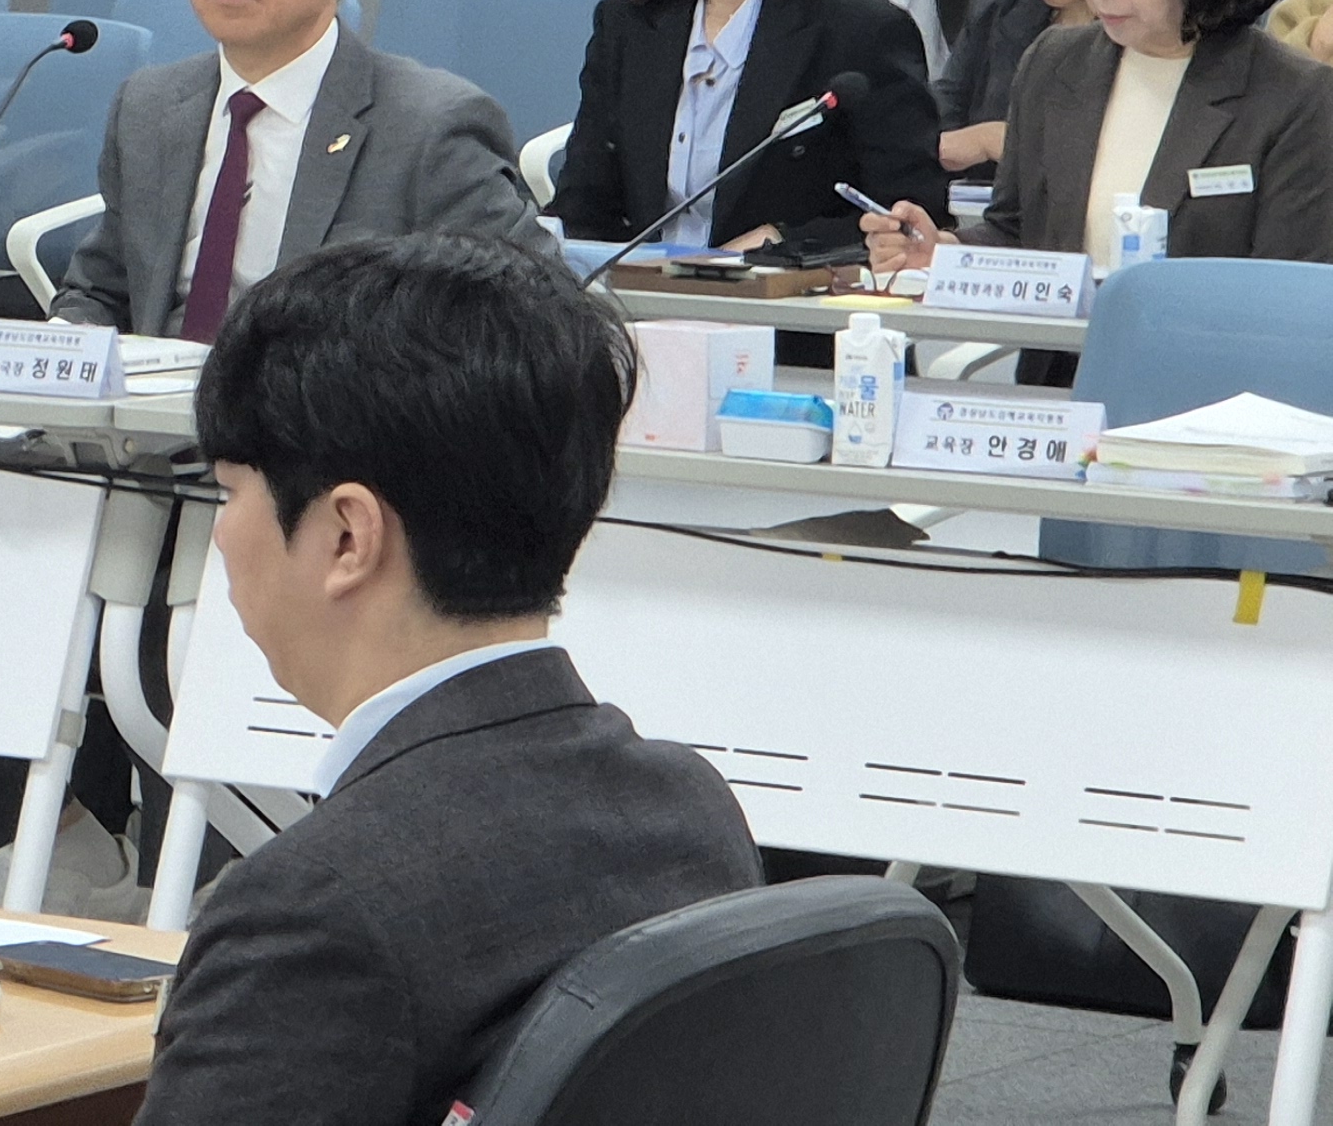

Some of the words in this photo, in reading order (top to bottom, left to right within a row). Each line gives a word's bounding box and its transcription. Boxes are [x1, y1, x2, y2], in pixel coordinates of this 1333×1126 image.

[1011, 279, 1073, 304] 이인숙
[32, 357, 99, 383] 정원태
[839, 400, 876, 419] WATER
[924, 435, 974, 456] 교육장
[987, 434, 1068, 464] 안경애
